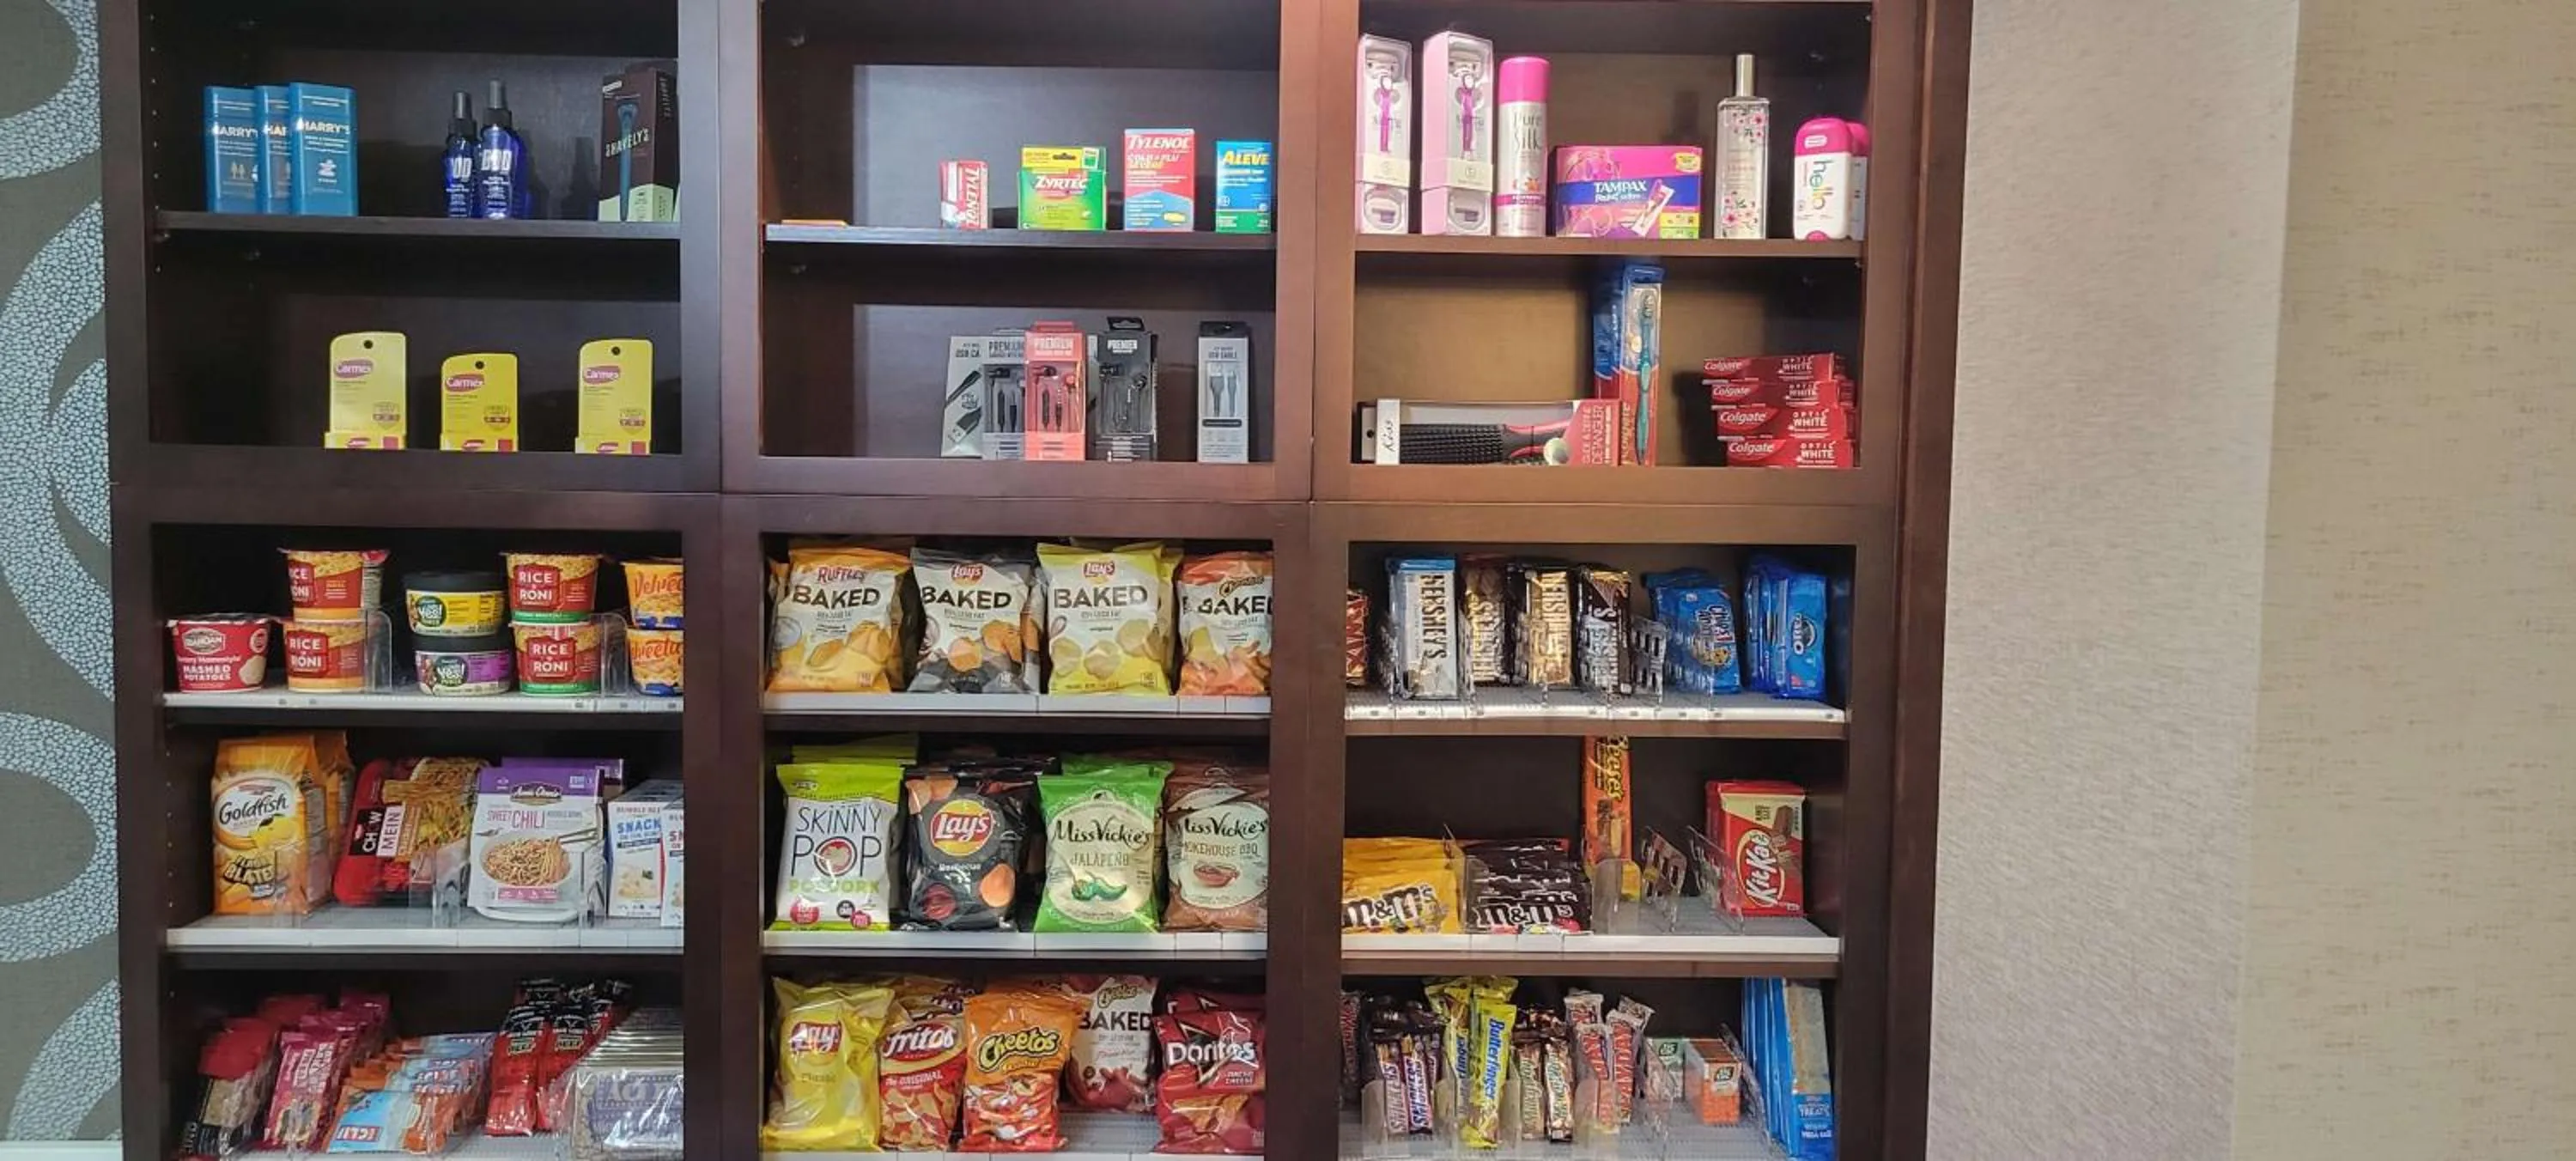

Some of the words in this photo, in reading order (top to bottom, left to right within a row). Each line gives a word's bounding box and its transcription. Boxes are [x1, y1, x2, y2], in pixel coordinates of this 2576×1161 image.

[1223, 150, 1270, 166] ALEVE
[1035, 173, 1089, 190] ZYRTEC
[1593, 180, 1648, 193] TAMPAX
[1809, 160, 1834, 211] hello
[1704, 359, 1743, 373] Colgate
[1713, 386, 1751, 398] Colgate
[1720, 410, 1767, 425] Colgate
[1792, 408, 1830, 418] OPTIC
[1792, 417, 1828, 427] WHITE
[1728, 441, 1774, 456] Colgate
[1800, 441, 1837, 449] OPTIC
[1800, 449, 1835, 459] WHITE
[519, 571, 553, 584] RICE
[519, 589, 553, 600] RONI
[793, 585, 881, 610] BAKED
[920, 587, 1012, 610] BAKED
[1054, 585, 1148, 609] BAKED
[1420, 574, 1447, 660] HERSHEY'S
[289, 638, 321, 650] RICE
[532, 643, 568, 654] RICE
[183, 665, 231, 674] MASHED
[290, 655, 322, 667] RONI
[533, 660, 568, 672] RONI
[219, 793, 289, 825] Goldfish
[512, 809, 546, 829] CHILI
[617, 817, 661, 835] SNACK
[796, 804, 882, 835] SKINNY
[934, 812, 990, 842] Lay's
[1208, 811, 1268, 841] Vickie's
[380, 811, 402, 851] MEIN
[1049, 819, 1095, 843] Miss
[1091, 814, 1151, 850] Vickie's
[791, 834, 883, 878] POP
[1746, 835, 1778, 905] KitKat
[1079, 1011, 1151, 1031] BAKED
[978, 1025, 1060, 1073] Cheetos
[1167, 1039, 1256, 1067] Doritos
[1482, 1018, 1505, 1101] Butterfinger
